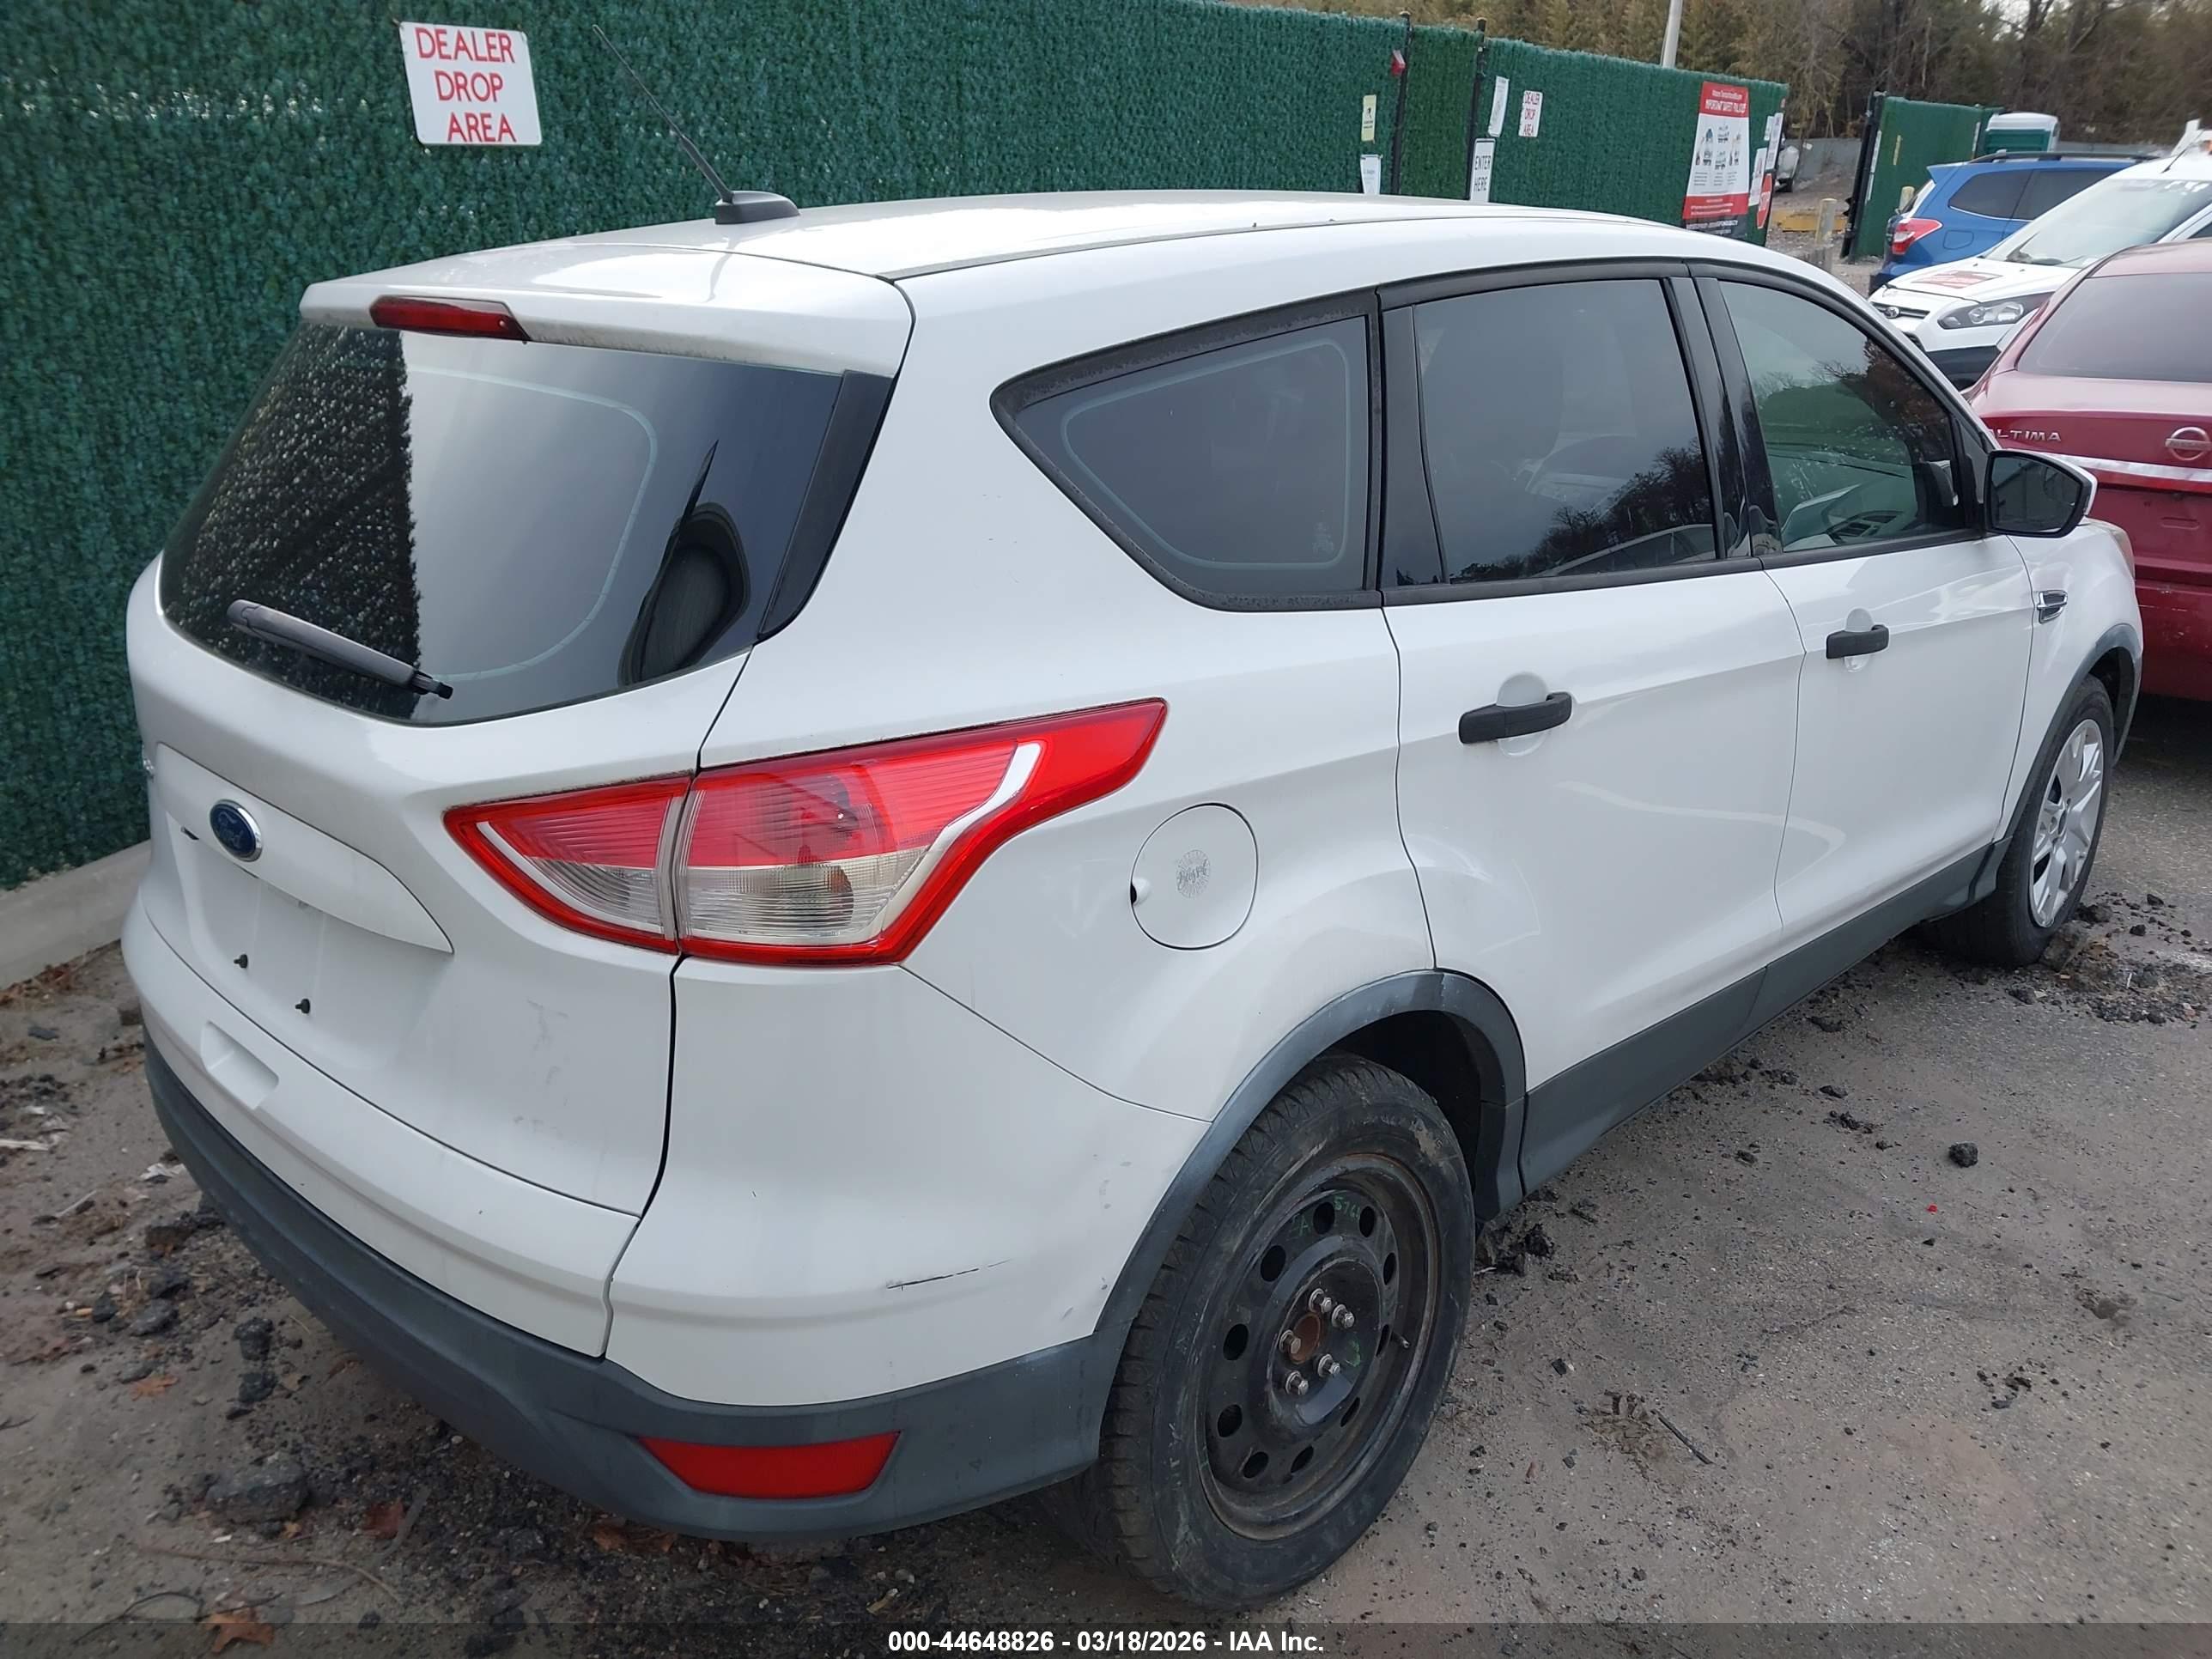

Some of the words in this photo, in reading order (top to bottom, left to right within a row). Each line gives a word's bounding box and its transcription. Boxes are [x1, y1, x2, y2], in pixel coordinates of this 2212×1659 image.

[415, 27, 515, 64] DEALER
[434, 70, 504, 102] DROP
[447, 111, 517, 143] AREA
[1474, 155, 1492, 170] ENTER
[1474, 176, 1489, 191] HERE
